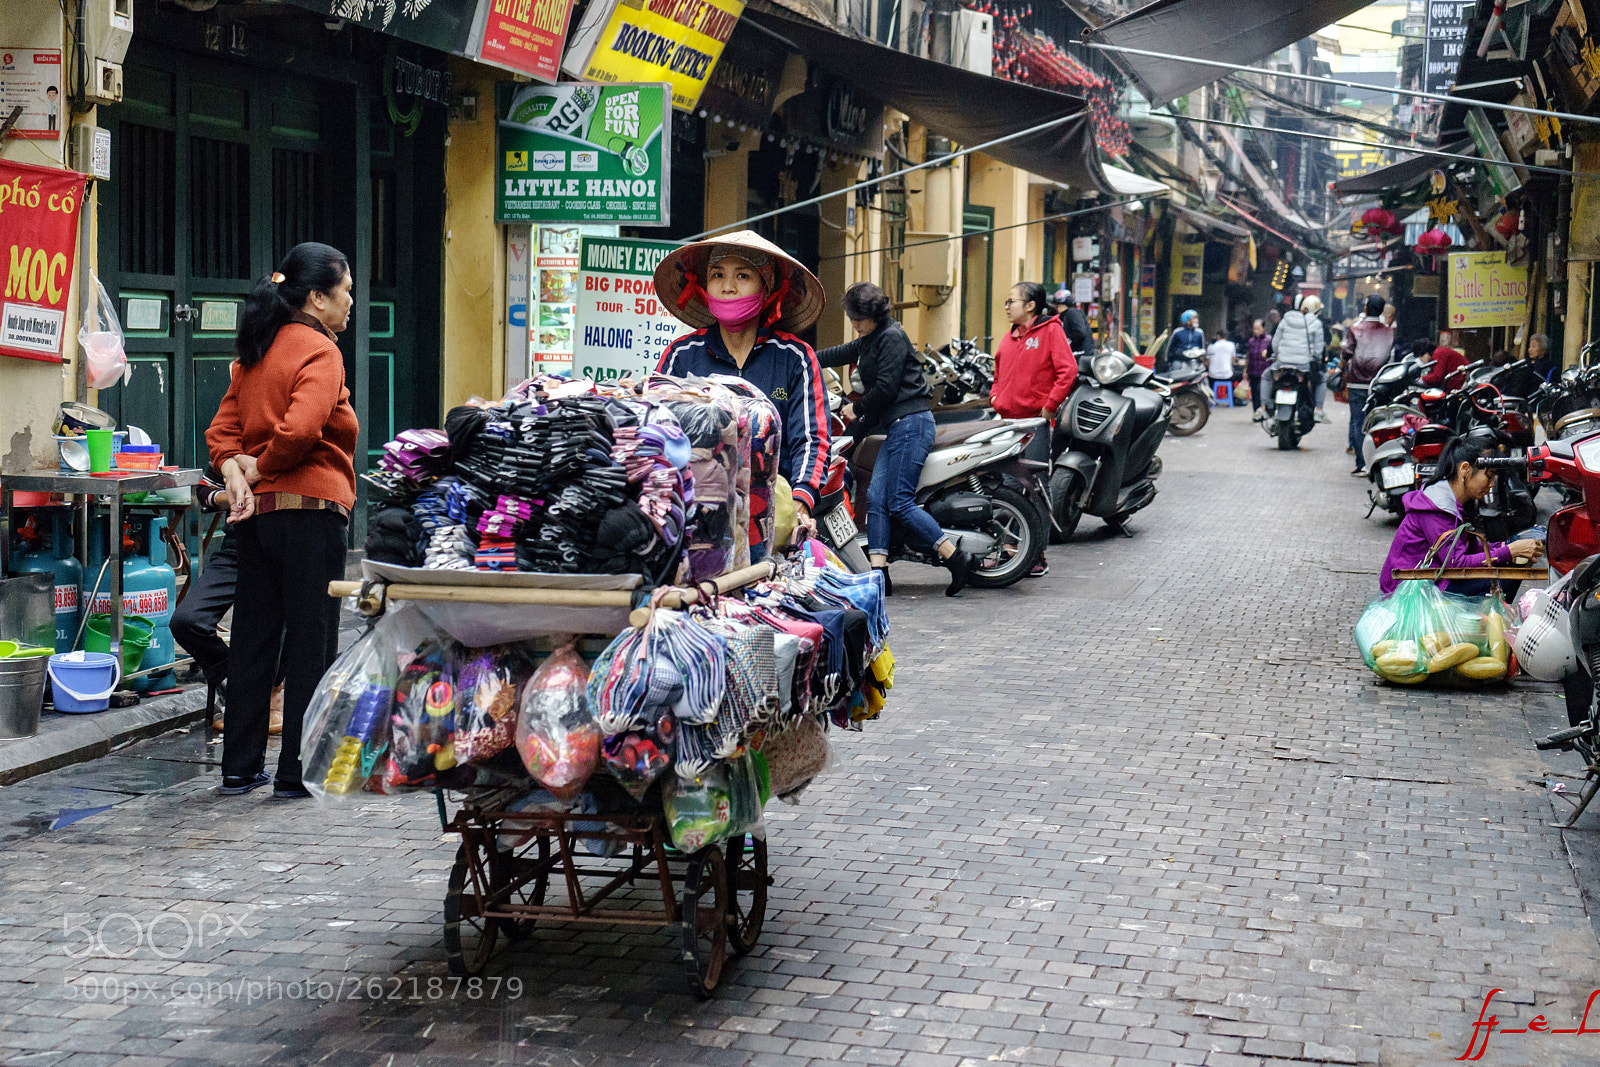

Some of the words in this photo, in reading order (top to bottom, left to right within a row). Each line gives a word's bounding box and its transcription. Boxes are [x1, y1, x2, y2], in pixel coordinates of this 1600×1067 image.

[612, 22, 675, 67] BOOKING
[668, 43, 713, 81] OFFICE
[606, 90, 639, 107] OPEN
[605, 103, 640, 121] FOR
[605, 119, 640, 139] FUN
[505, 179, 579, 196] LITTLE
[586, 179, 656, 197] HANOI
[48, 185, 78, 214] cổ
[587, 244, 633, 271] MONEY
[585, 276, 609, 292] BIG
[1454, 272, 1484, 299] Little
[596, 301, 623, 313] TOUR
[655, 322, 677, 334] day
[584, 326, 633, 349] HALONG
[644, 336, 650, 344] 2
[654, 337, 673, 346] da
[1025, 336, 1040, 350] 94
[643, 350, 649, 359] 3
